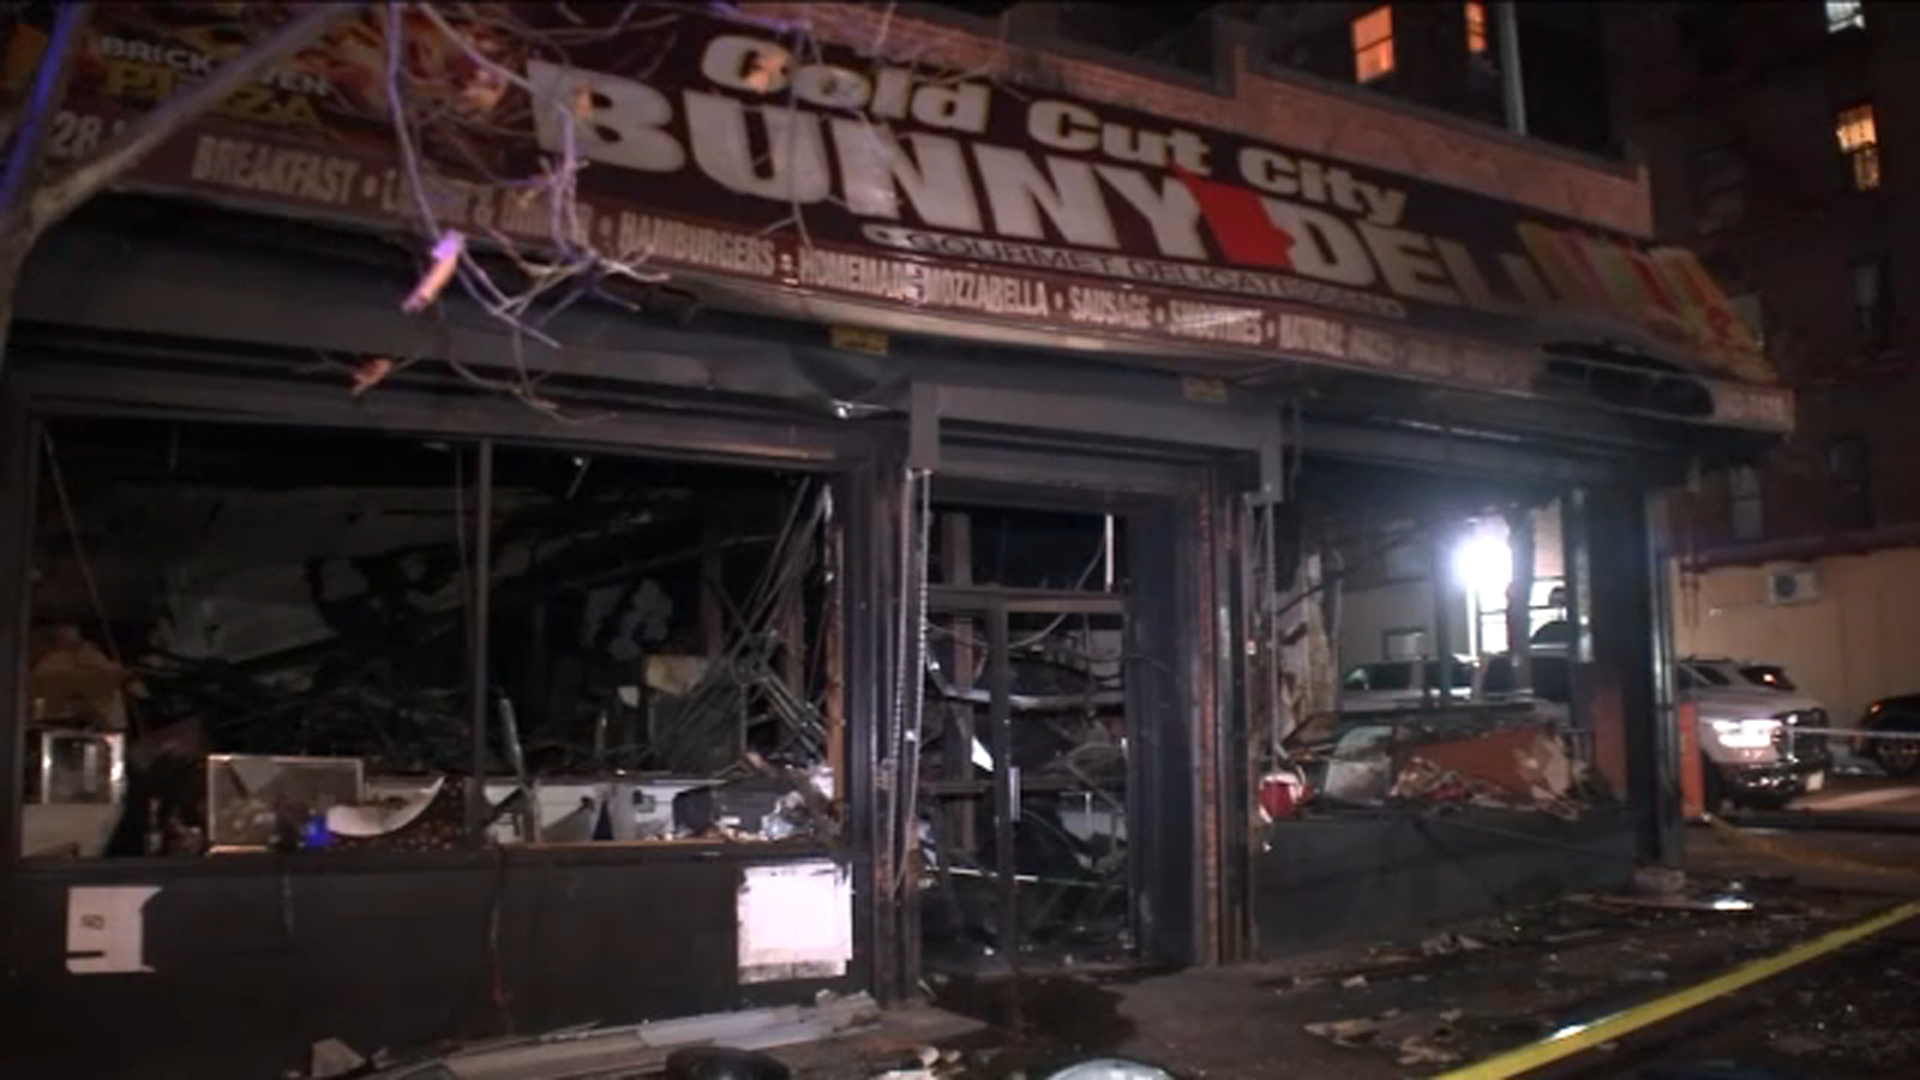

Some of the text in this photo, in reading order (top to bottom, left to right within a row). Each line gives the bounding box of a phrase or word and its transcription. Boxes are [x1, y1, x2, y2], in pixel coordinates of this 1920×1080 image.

[102, 35, 217, 75] BRICK
[105, 60, 333, 130] PIZA
[526, 58, 1209, 261] BUNNY
[701, 34, 1408, 229] Cold Cut City
[191, 134, 360, 204] BREAKFAST
[617, 210, 777, 275] HAMBURGERS
[924, 265, 1048, 317] MOZZARELLA
[1068, 284, 1151, 328] SAUSAGE
[906, 233, 1382, 316] GOURMET DELICATE
